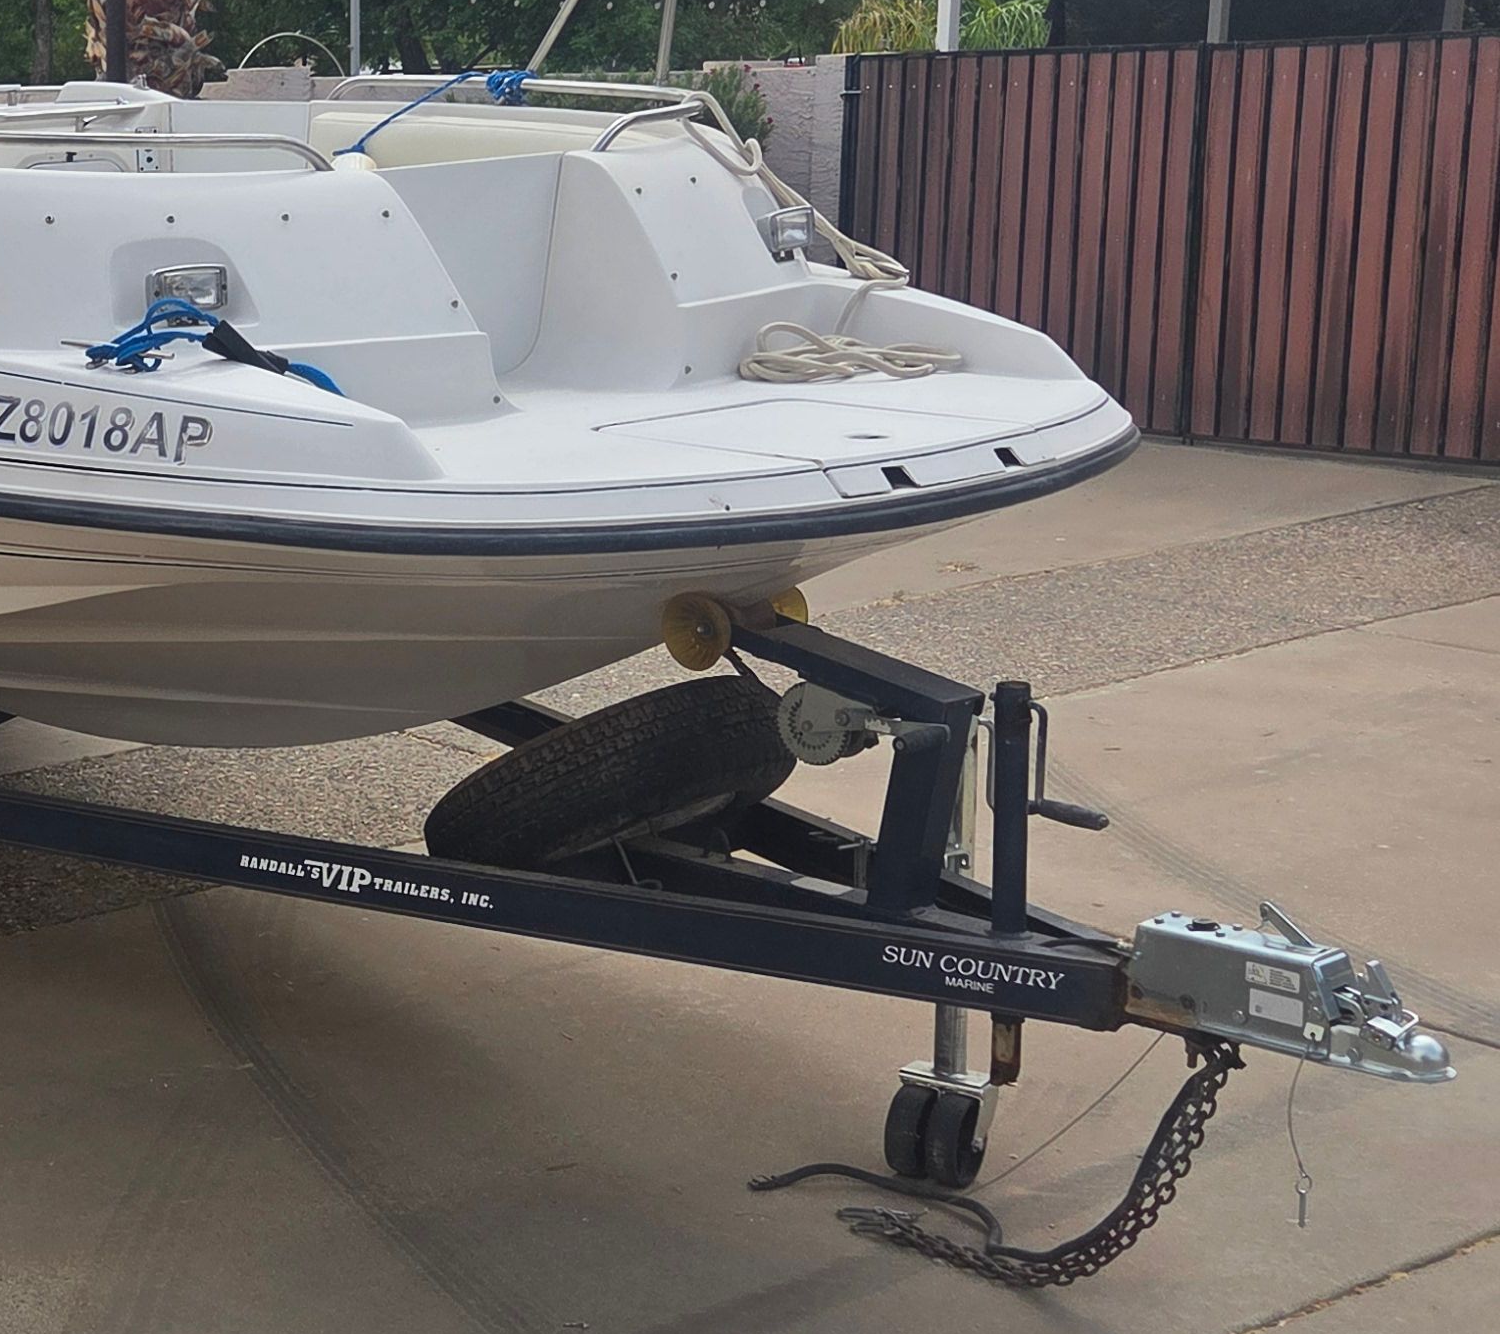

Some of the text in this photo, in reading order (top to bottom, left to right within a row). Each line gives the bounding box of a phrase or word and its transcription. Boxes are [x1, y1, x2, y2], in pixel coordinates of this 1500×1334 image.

[240, 854, 495, 909] RANDALL'S VIP TRAILERS, INC.
[882, 945, 1065, 990] SUN COUNTRY
[944, 975, 995, 995] MARINE
